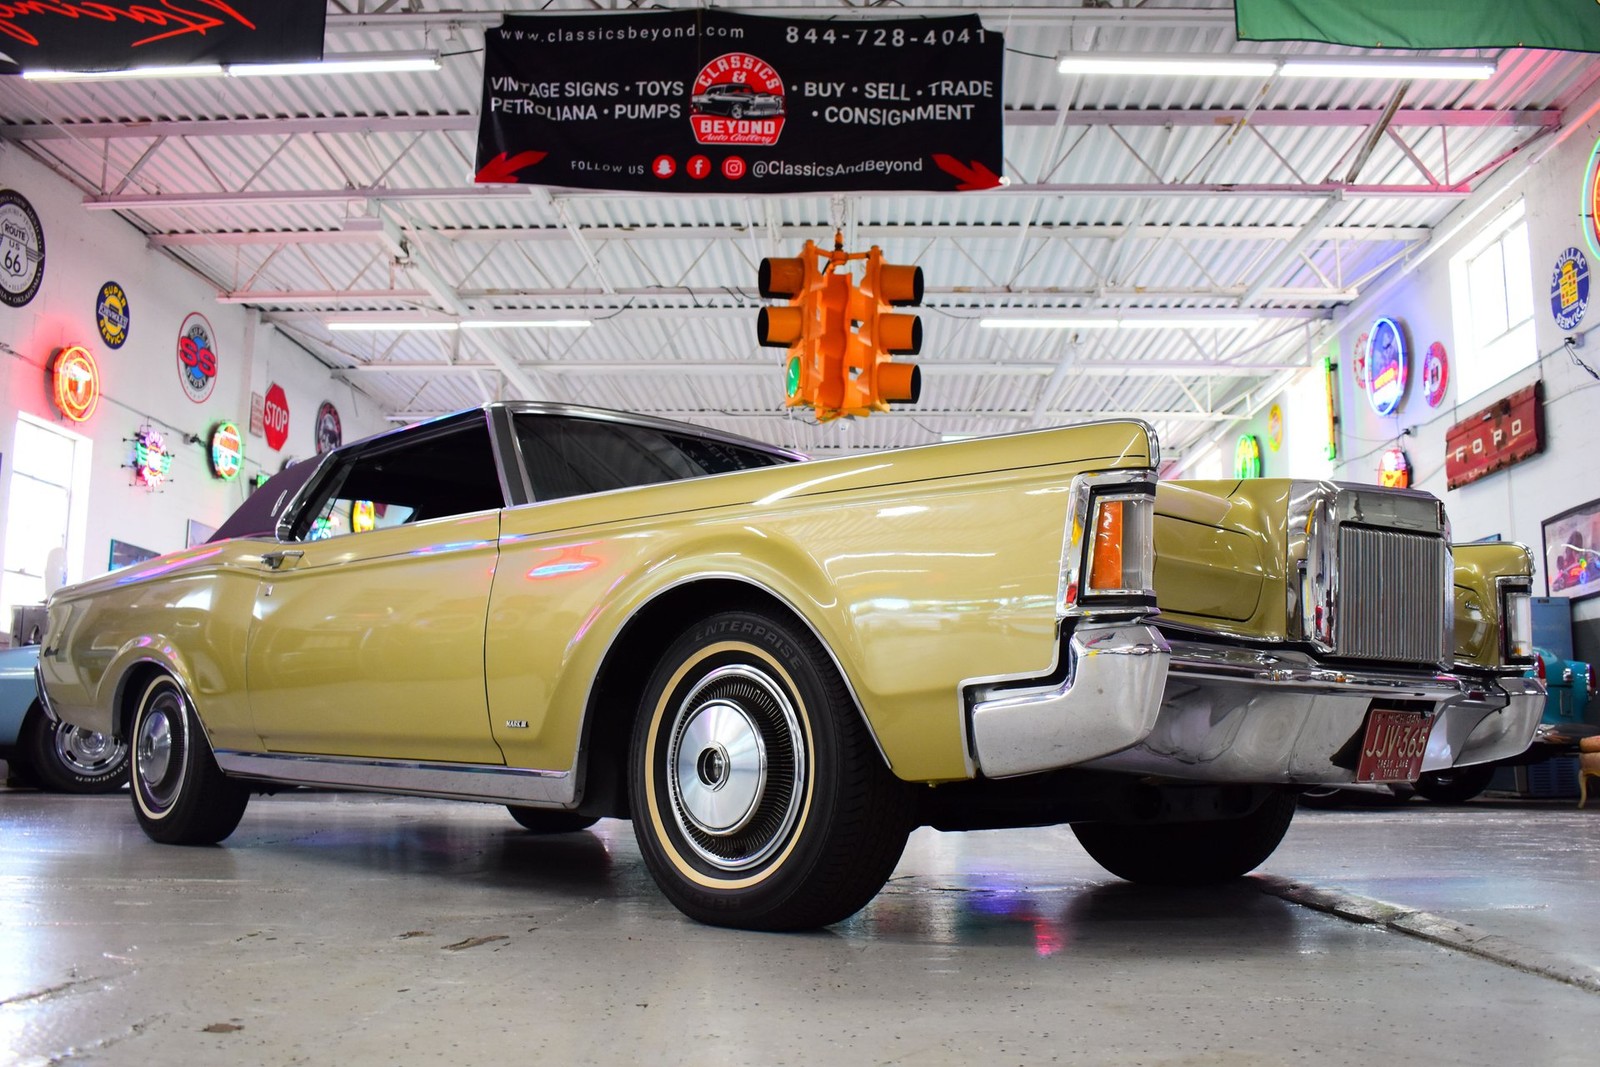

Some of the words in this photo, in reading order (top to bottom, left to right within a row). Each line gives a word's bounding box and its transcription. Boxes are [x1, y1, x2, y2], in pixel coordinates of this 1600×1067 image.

[500, 24, 744, 42] www.classicsbeyond.com
[786, 26, 985, 47] 844-728-4041
[698, 56, 780, 89] CLASSICS
[732, 71, 747, 83] &
[491, 76, 560, 98] VINTAGE
[564, 82, 619, 97] SIGNS
[635, 81, 684, 96] TOYS
[804, 82, 845, 97] BUY
[864, 82, 911, 101] SELL
[928, 81, 993, 97] TRADE
[491, 97, 598, 121] PETROLIANA
[614, 104, 681, 120] PUMPS
[824, 104, 975, 125] CONSIGNMENT
[700, 120, 775, 134] BEYOND
[571, 160, 622, 173] FOLLOW
[628, 165, 645, 175] US
[752, 158, 922, 177] @ClassicsAndBeyond
[4, 223, 26, 241] ROUTE
[9, 239, 20, 251] US
[4, 250, 21, 273] 66
[1552, 248, 1585, 287] CADILLAC
[104, 286, 126, 307] SUPER
[1556, 297, 1589, 329] SERVICE
[100, 319, 125, 345] SERVICE
[180, 335, 216, 377] SS
[264, 400, 288, 434] STOP
[695, 621, 802, 670] ENTERPRISE
